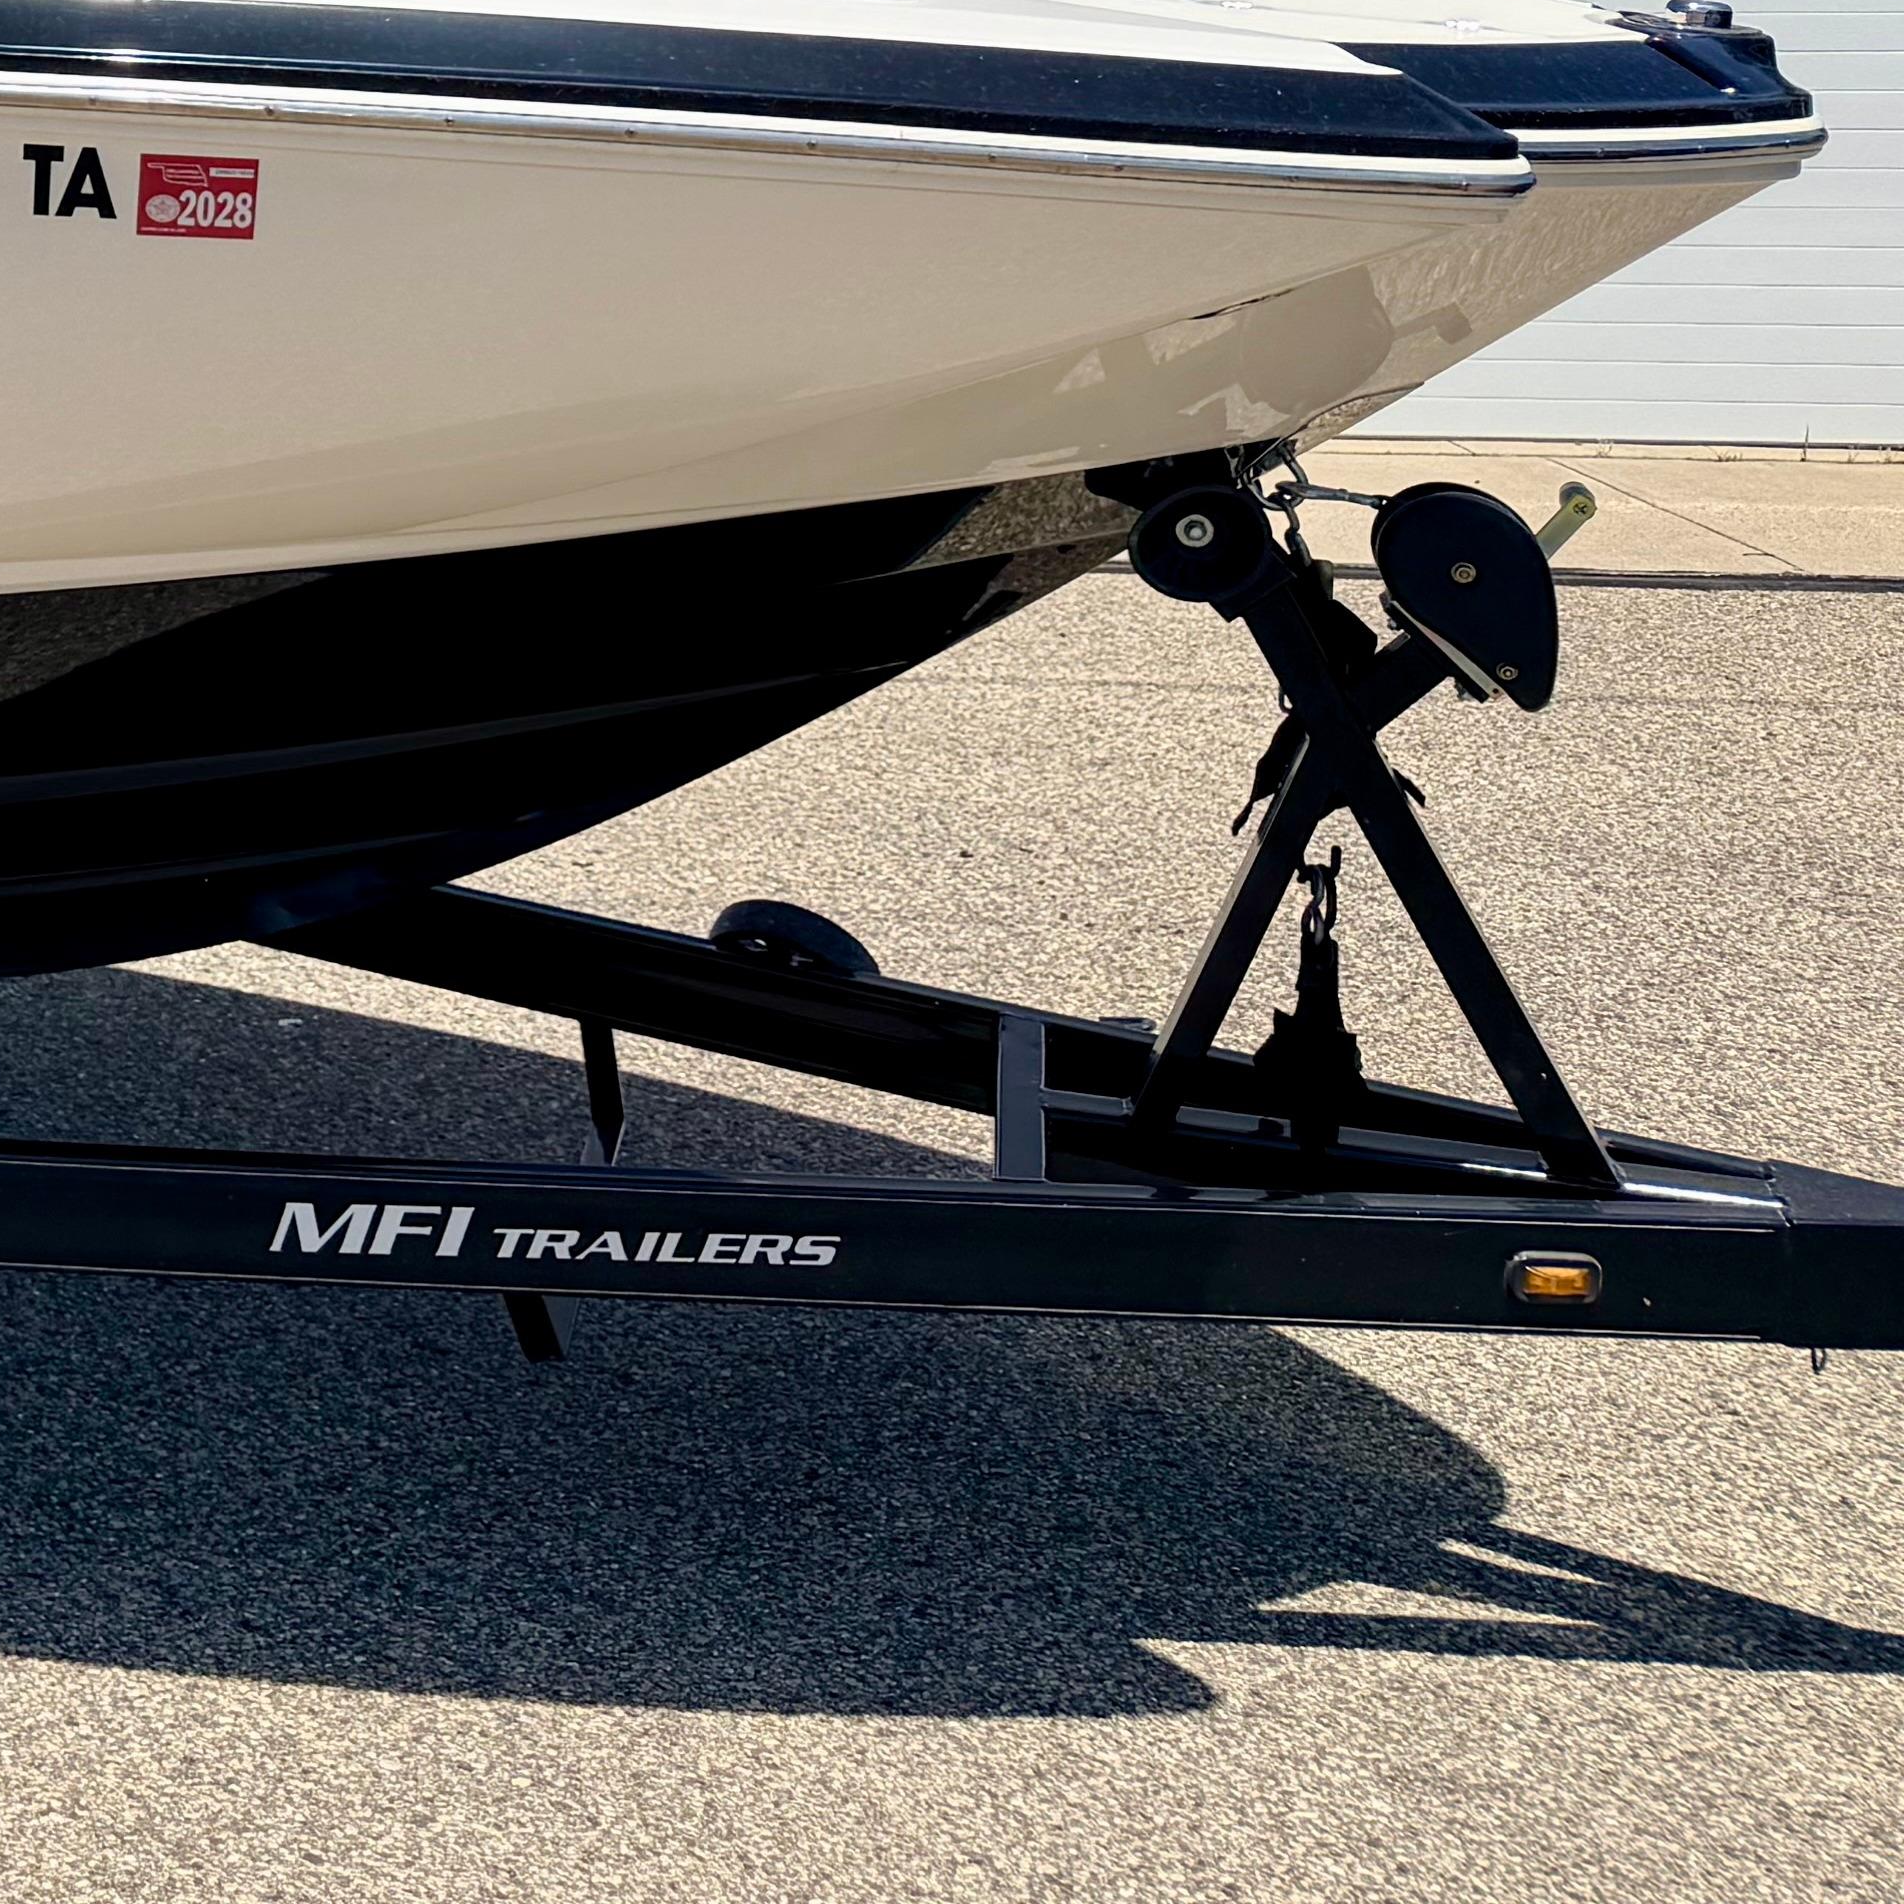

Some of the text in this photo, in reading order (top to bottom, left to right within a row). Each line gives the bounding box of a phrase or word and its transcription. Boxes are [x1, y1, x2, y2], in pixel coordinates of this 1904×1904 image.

[23, 144, 117, 219] TA
[177, 190, 253, 228] 2028
[270, 1203, 840, 1265] MFI TRAILERS
